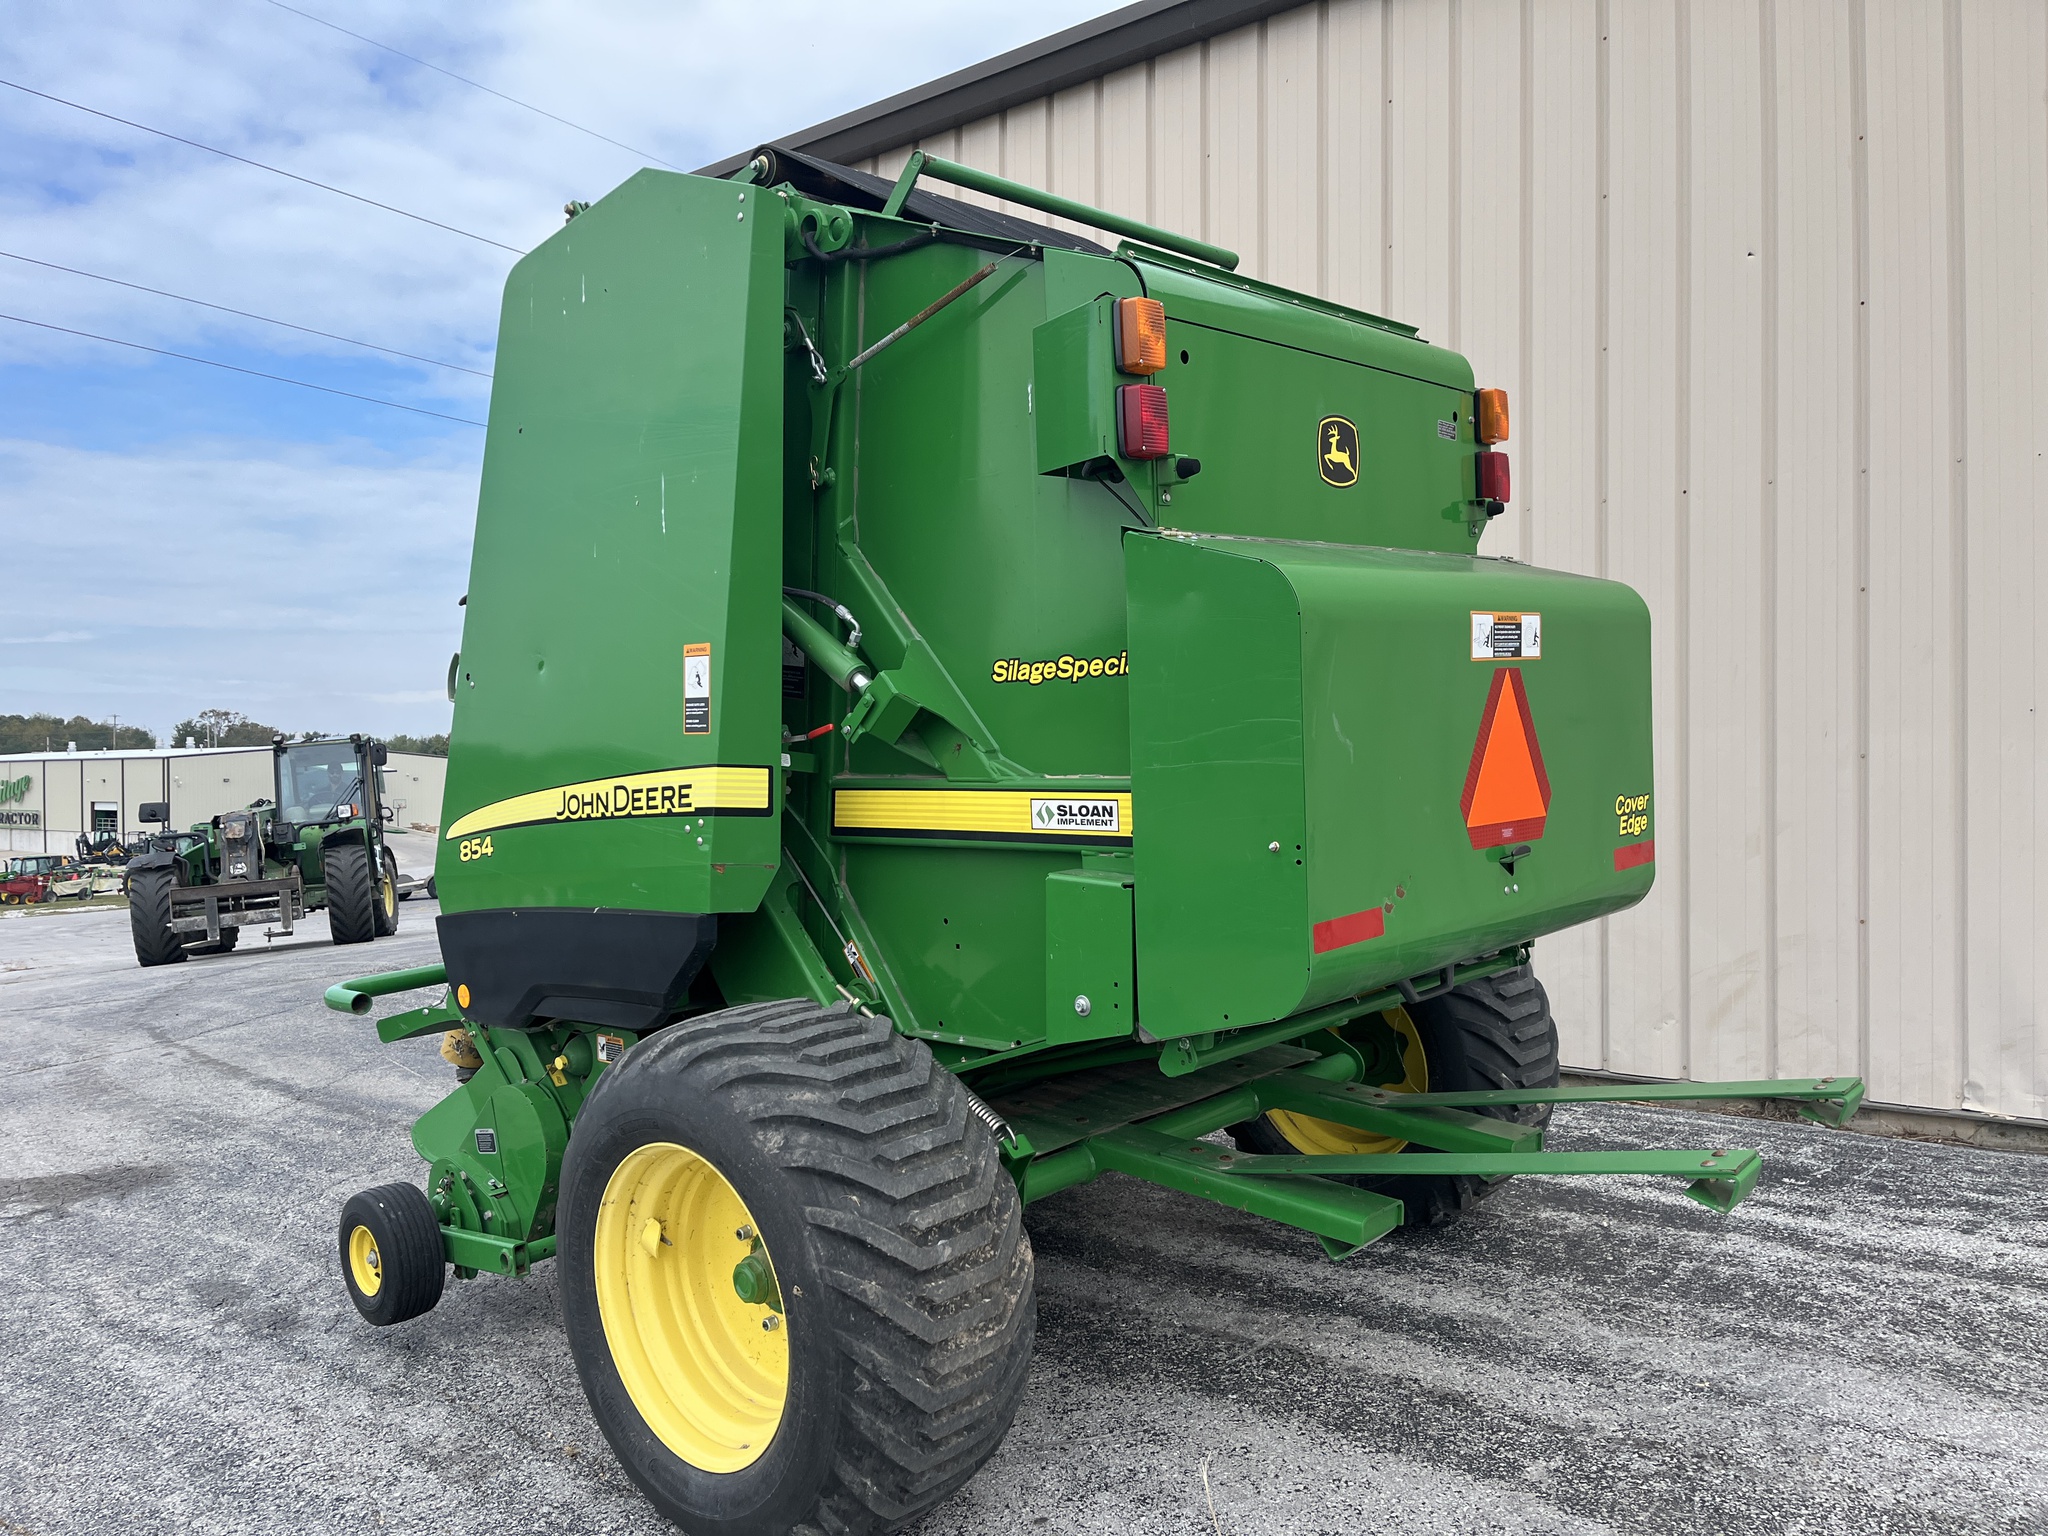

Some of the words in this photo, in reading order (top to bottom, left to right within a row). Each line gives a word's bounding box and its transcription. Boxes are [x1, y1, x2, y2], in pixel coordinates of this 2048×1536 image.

[991, 650, 1128, 685] SilageSpeci
[556, 790, 609, 816] JOHN
[613, 783, 692, 812] DEERE
[1056, 804, 1113, 818] SLOAN
[1615, 793, 1650, 815] Cover
[1057, 818, 1114, 827] IMPLEMENT
[1619, 813, 1648, 836] Edge
[459, 835, 494, 862] 854
